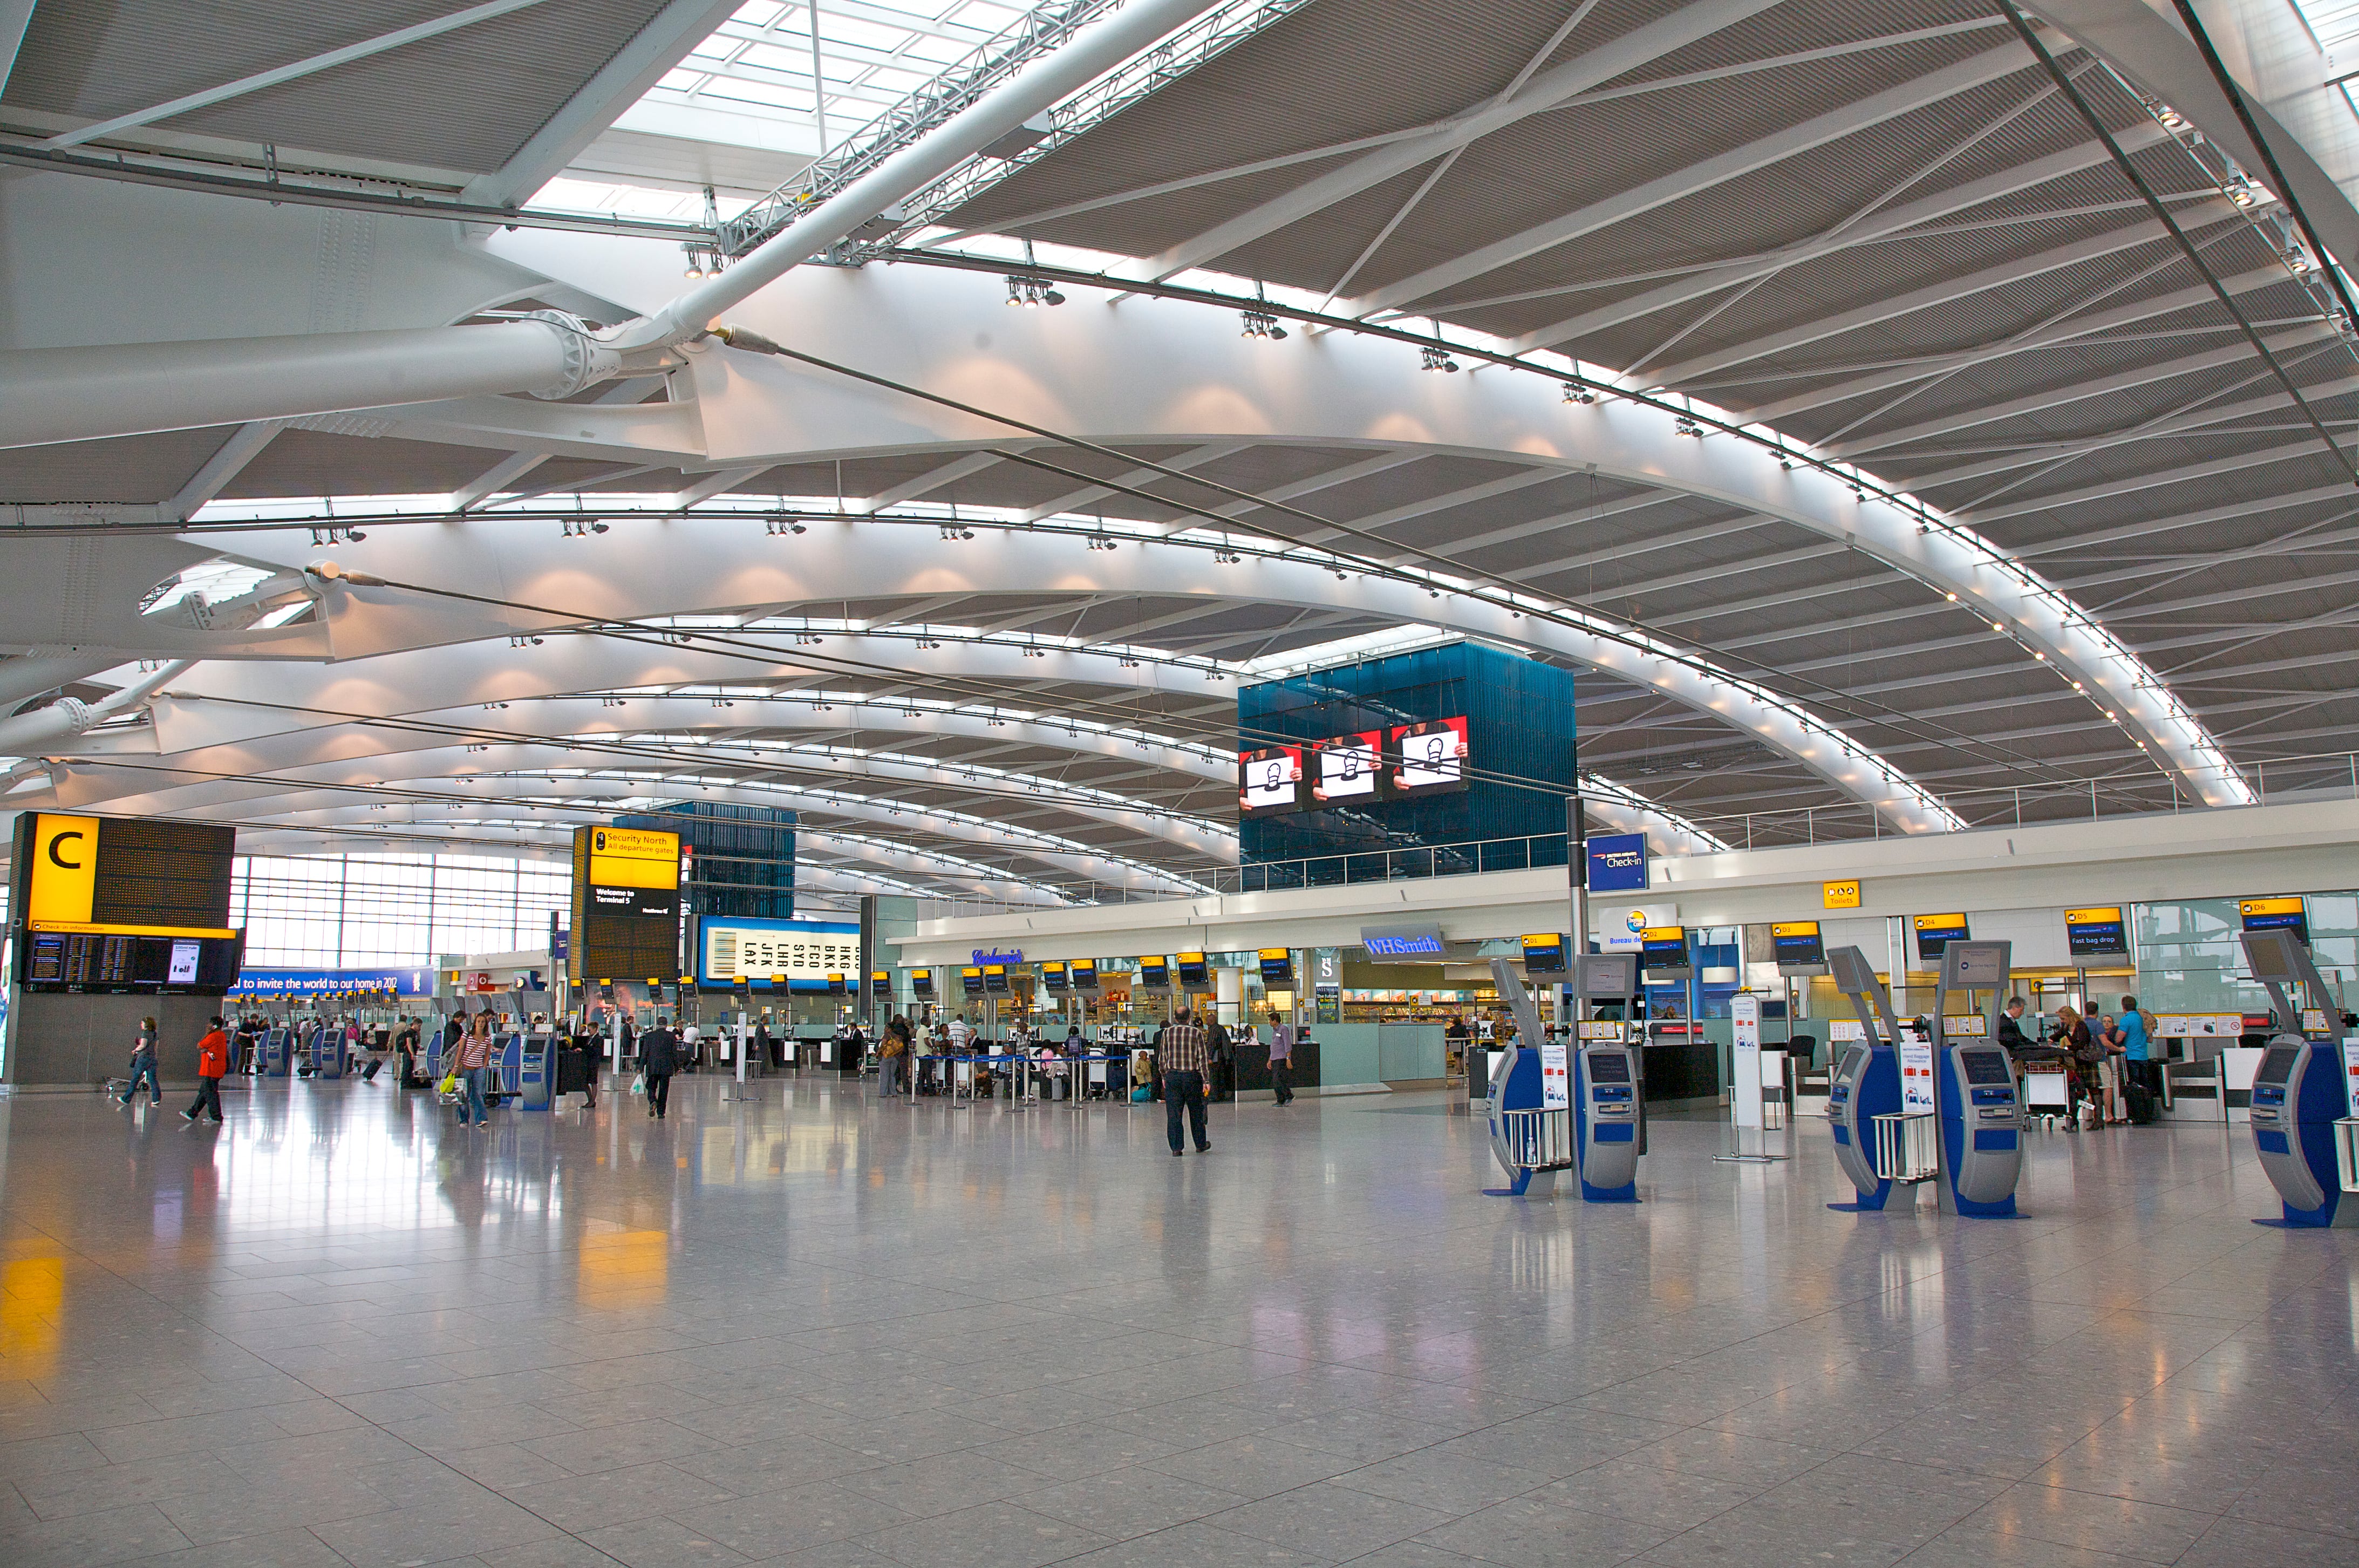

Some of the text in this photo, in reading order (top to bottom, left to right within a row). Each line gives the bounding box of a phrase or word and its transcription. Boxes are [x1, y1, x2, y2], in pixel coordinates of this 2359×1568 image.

[49, 831, 83, 869] C
[608, 833, 667, 845] Security North
[619, 843, 653, 853] departure
[1607, 856, 1641, 867] Check-in
[745, 942, 756, 965] LAX
[761, 943, 773, 966] JFK
[777, 944, 789, 967] LHR
[793, 944, 804, 967] SYD
[809, 945, 820, 968] FCO
[1363, 935, 1442, 955] WHSmith
[824, 945, 835, 969] BKK
[840, 946, 850, 969] HKG
[1322, 962, 1333, 977] S
[243, 977, 254, 988] to
[257, 978, 283, 989] invite
[286, 978, 301, 989] the
[303, 978, 327, 989] world
[330, 979, 338, 988] to
[340, 980, 354, 988] our
[355, 978, 374, 989] home
[376, 978, 383, 988] in
[384, 977, 398, 988] 2012
